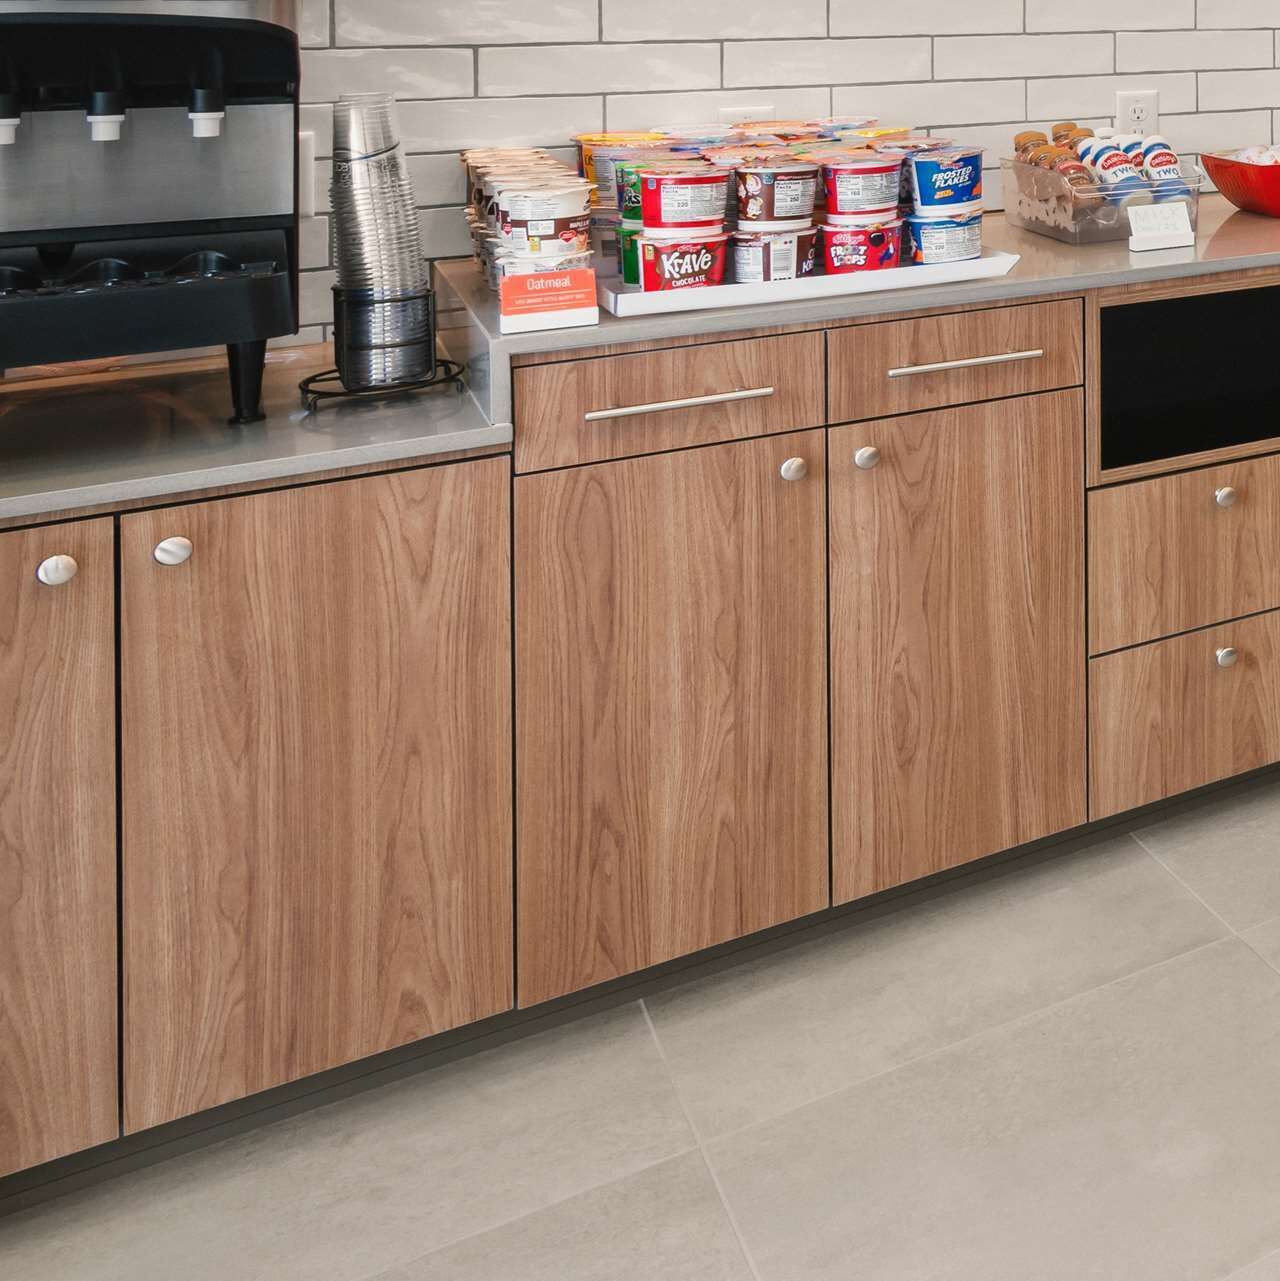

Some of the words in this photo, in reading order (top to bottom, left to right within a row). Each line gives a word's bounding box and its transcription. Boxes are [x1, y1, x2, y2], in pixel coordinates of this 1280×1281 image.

[931, 166, 972, 183] FROSTED
[1156, 167, 1179, 179] TWO
[934, 175, 969, 189] FLAKES
[833, 254, 867, 268] LOOPS
[527, 275, 572, 291] Oatmeal
[672, 274, 706, 287] CHOCOLATE
